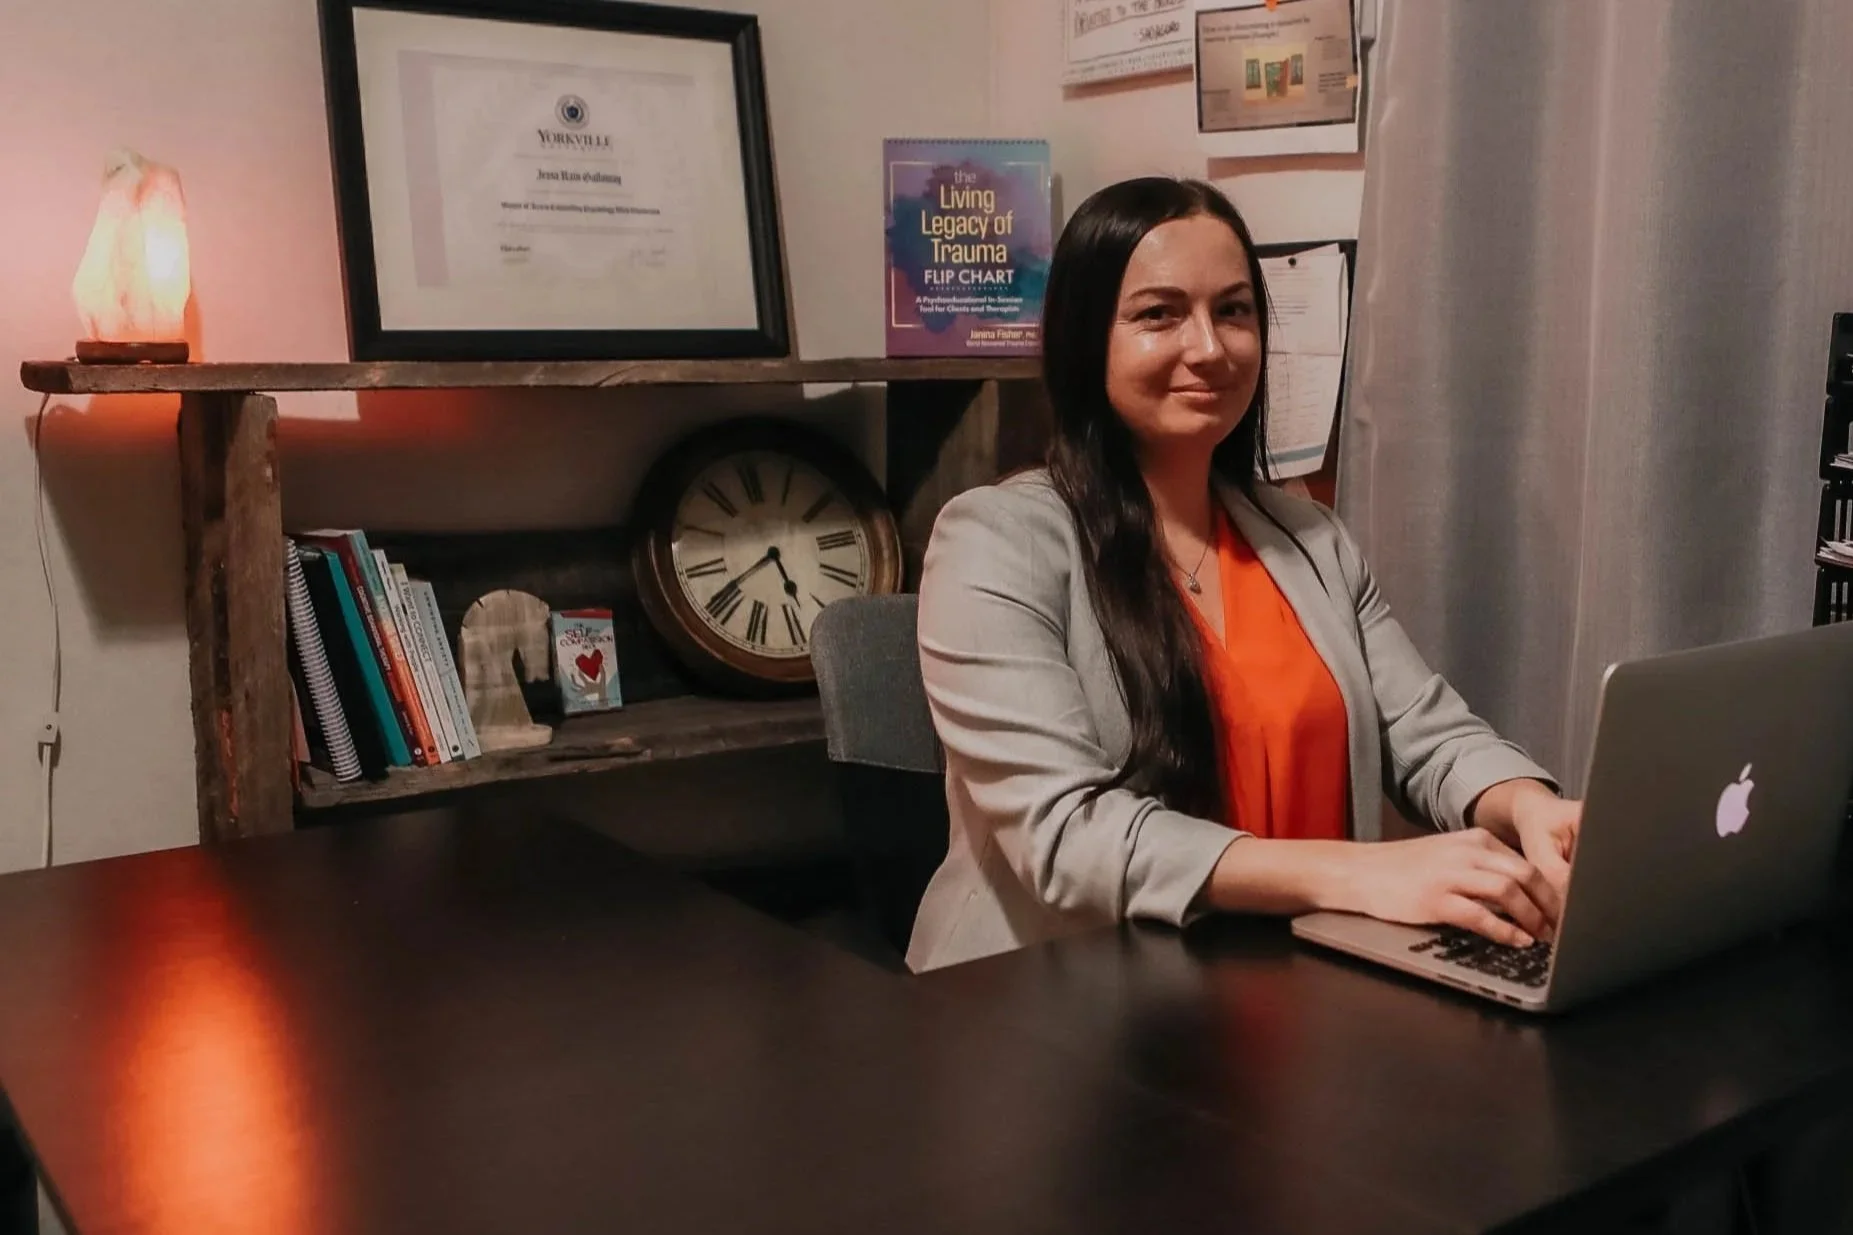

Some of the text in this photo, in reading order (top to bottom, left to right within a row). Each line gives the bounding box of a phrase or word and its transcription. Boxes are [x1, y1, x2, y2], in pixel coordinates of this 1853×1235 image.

[537, 128, 611, 146] YORKVILLE
[953, 169, 977, 185] the
[939, 184, 996, 214] Living
[921, 209, 1014, 240] Legacy of
[930, 238, 1008, 264] Trauma
[923, 269, 1015, 285] FLIP CHART
[915, 295, 922, 304] A
[919, 304, 934, 313] Tool
[935, 304, 946, 313] for
[946, 304, 970, 313] Clients
[970, 304, 985, 313] and
[970, 328, 996, 340] Janina
[402, 586, 415, 610] Want
[409, 610, 418, 620] to
[412, 621, 432, 663] CONNECT
